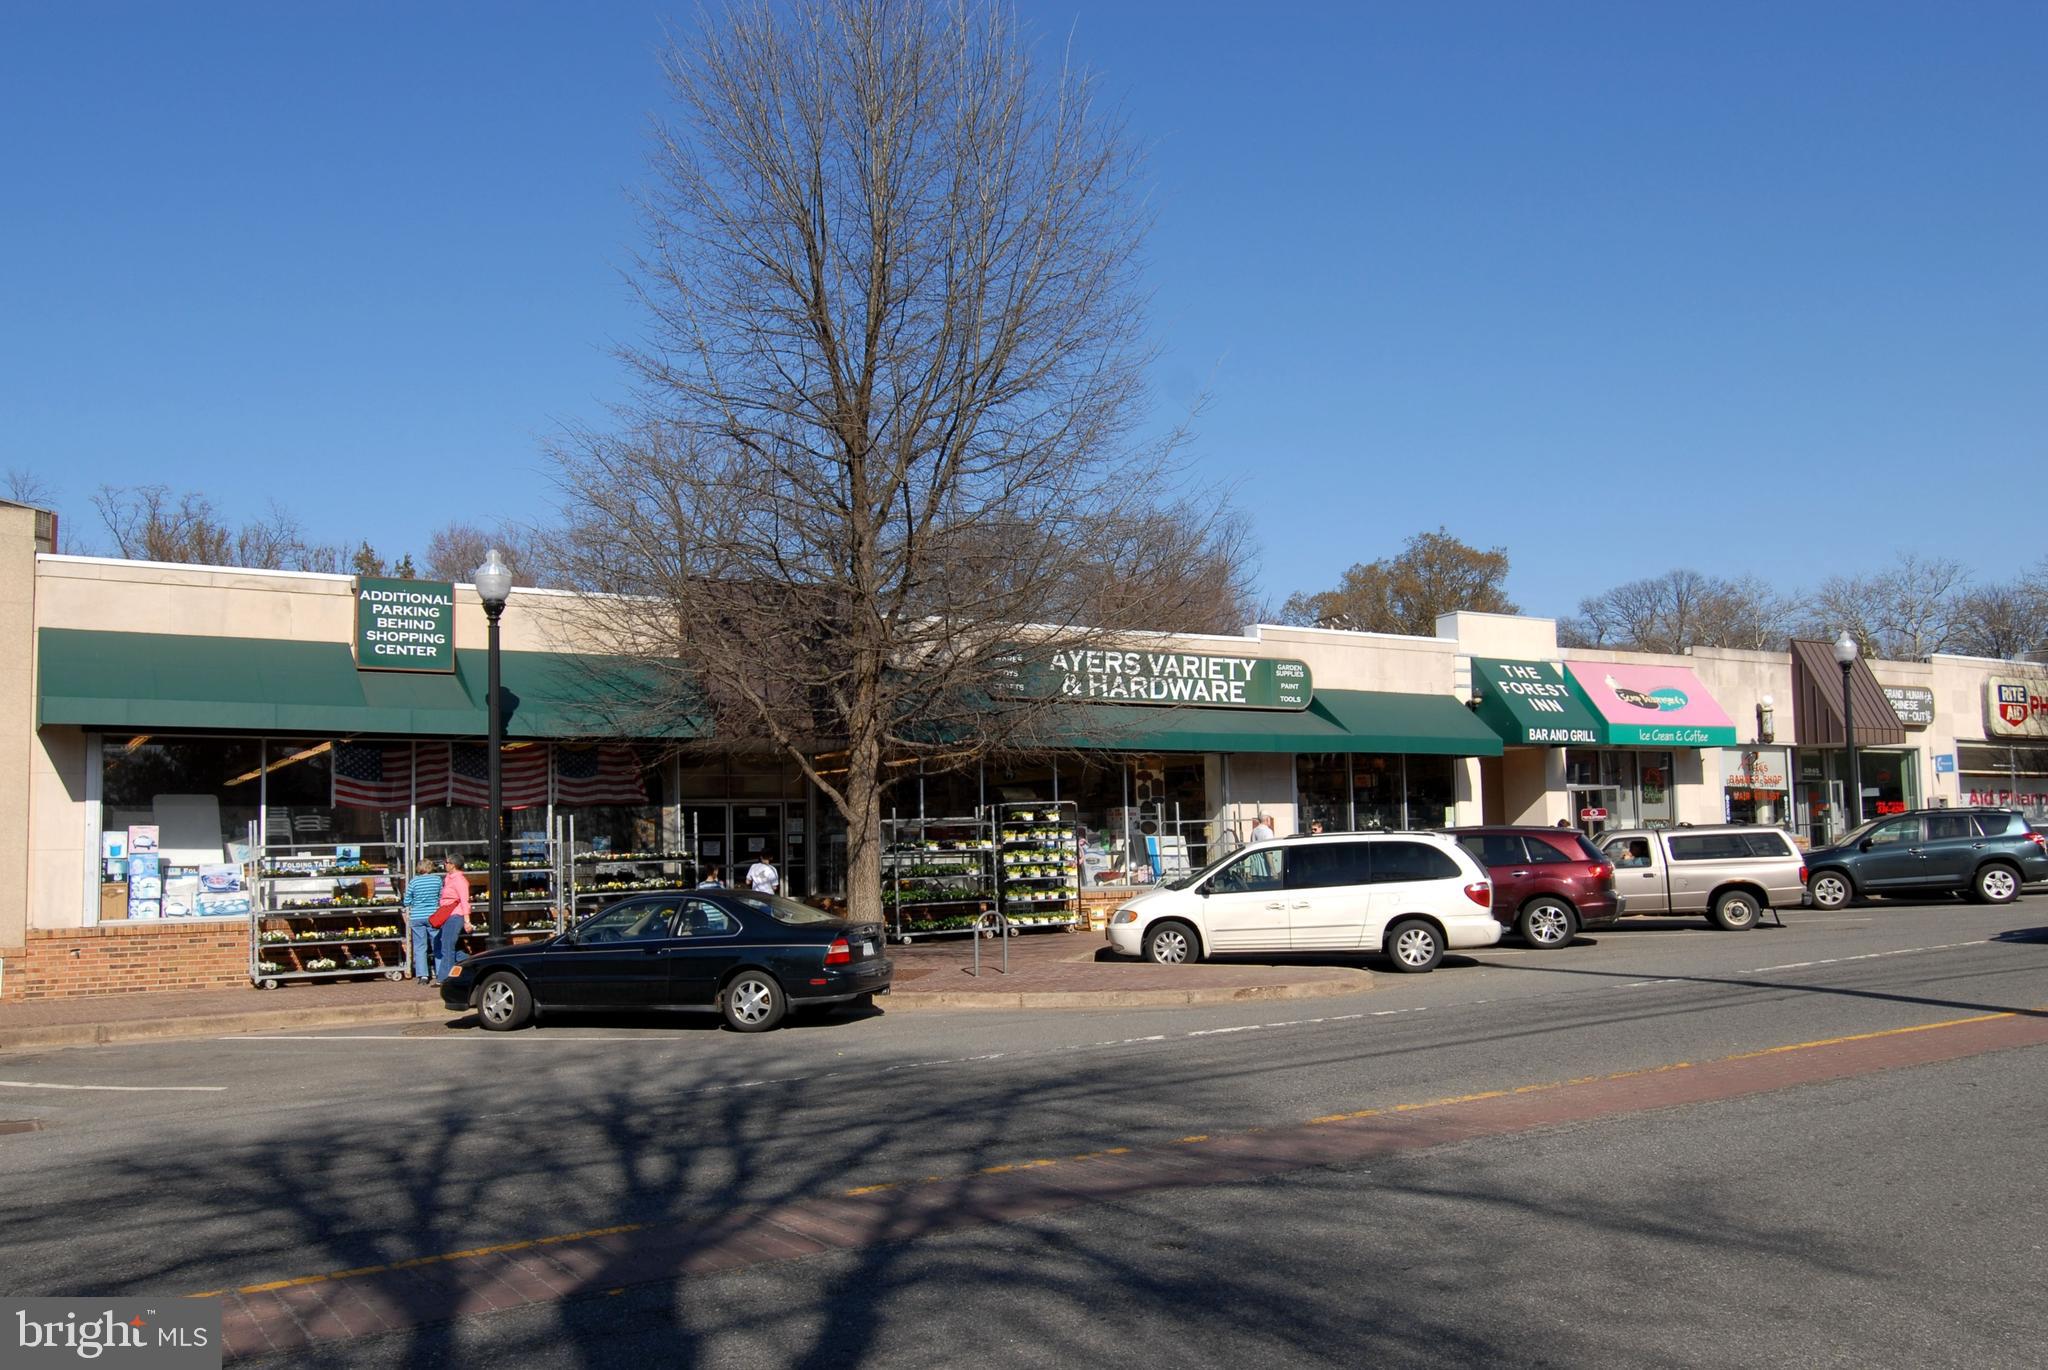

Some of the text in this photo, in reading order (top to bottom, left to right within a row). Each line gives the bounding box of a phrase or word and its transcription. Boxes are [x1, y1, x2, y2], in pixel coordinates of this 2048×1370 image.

[360, 590, 453, 606] ADDITIONAL
[372, 604, 440, 617] PARKING
[377, 617, 436, 630] BEHIND
[366, 630, 445, 644] SHOPPING
[374, 644, 437, 657] CENTER
[1049, 649, 1257, 681] AYERS VARIETY
[1277, 664, 1303, 672] GARDEN
[1499, 664, 1542, 680] THE
[1275, 670, 1304, 678] SUPPLIES
[1062, 672, 1246, 703] & HARDWARE
[1280, 682, 1299, 690] PAINT
[1498, 681, 1569, 697] FOREST
[1280, 695, 1302, 703] TOOLS
[2001, 686, 2025, 702] RITE
[1528, 698, 1565, 713] INN
[2006, 705, 2024, 721] AID
[1528, 728, 1596, 743] BAR AND GRILL
[1639, 729, 1709, 743] Ice Cream & Coffee
[1968, 788, 1995, 806] Aid
